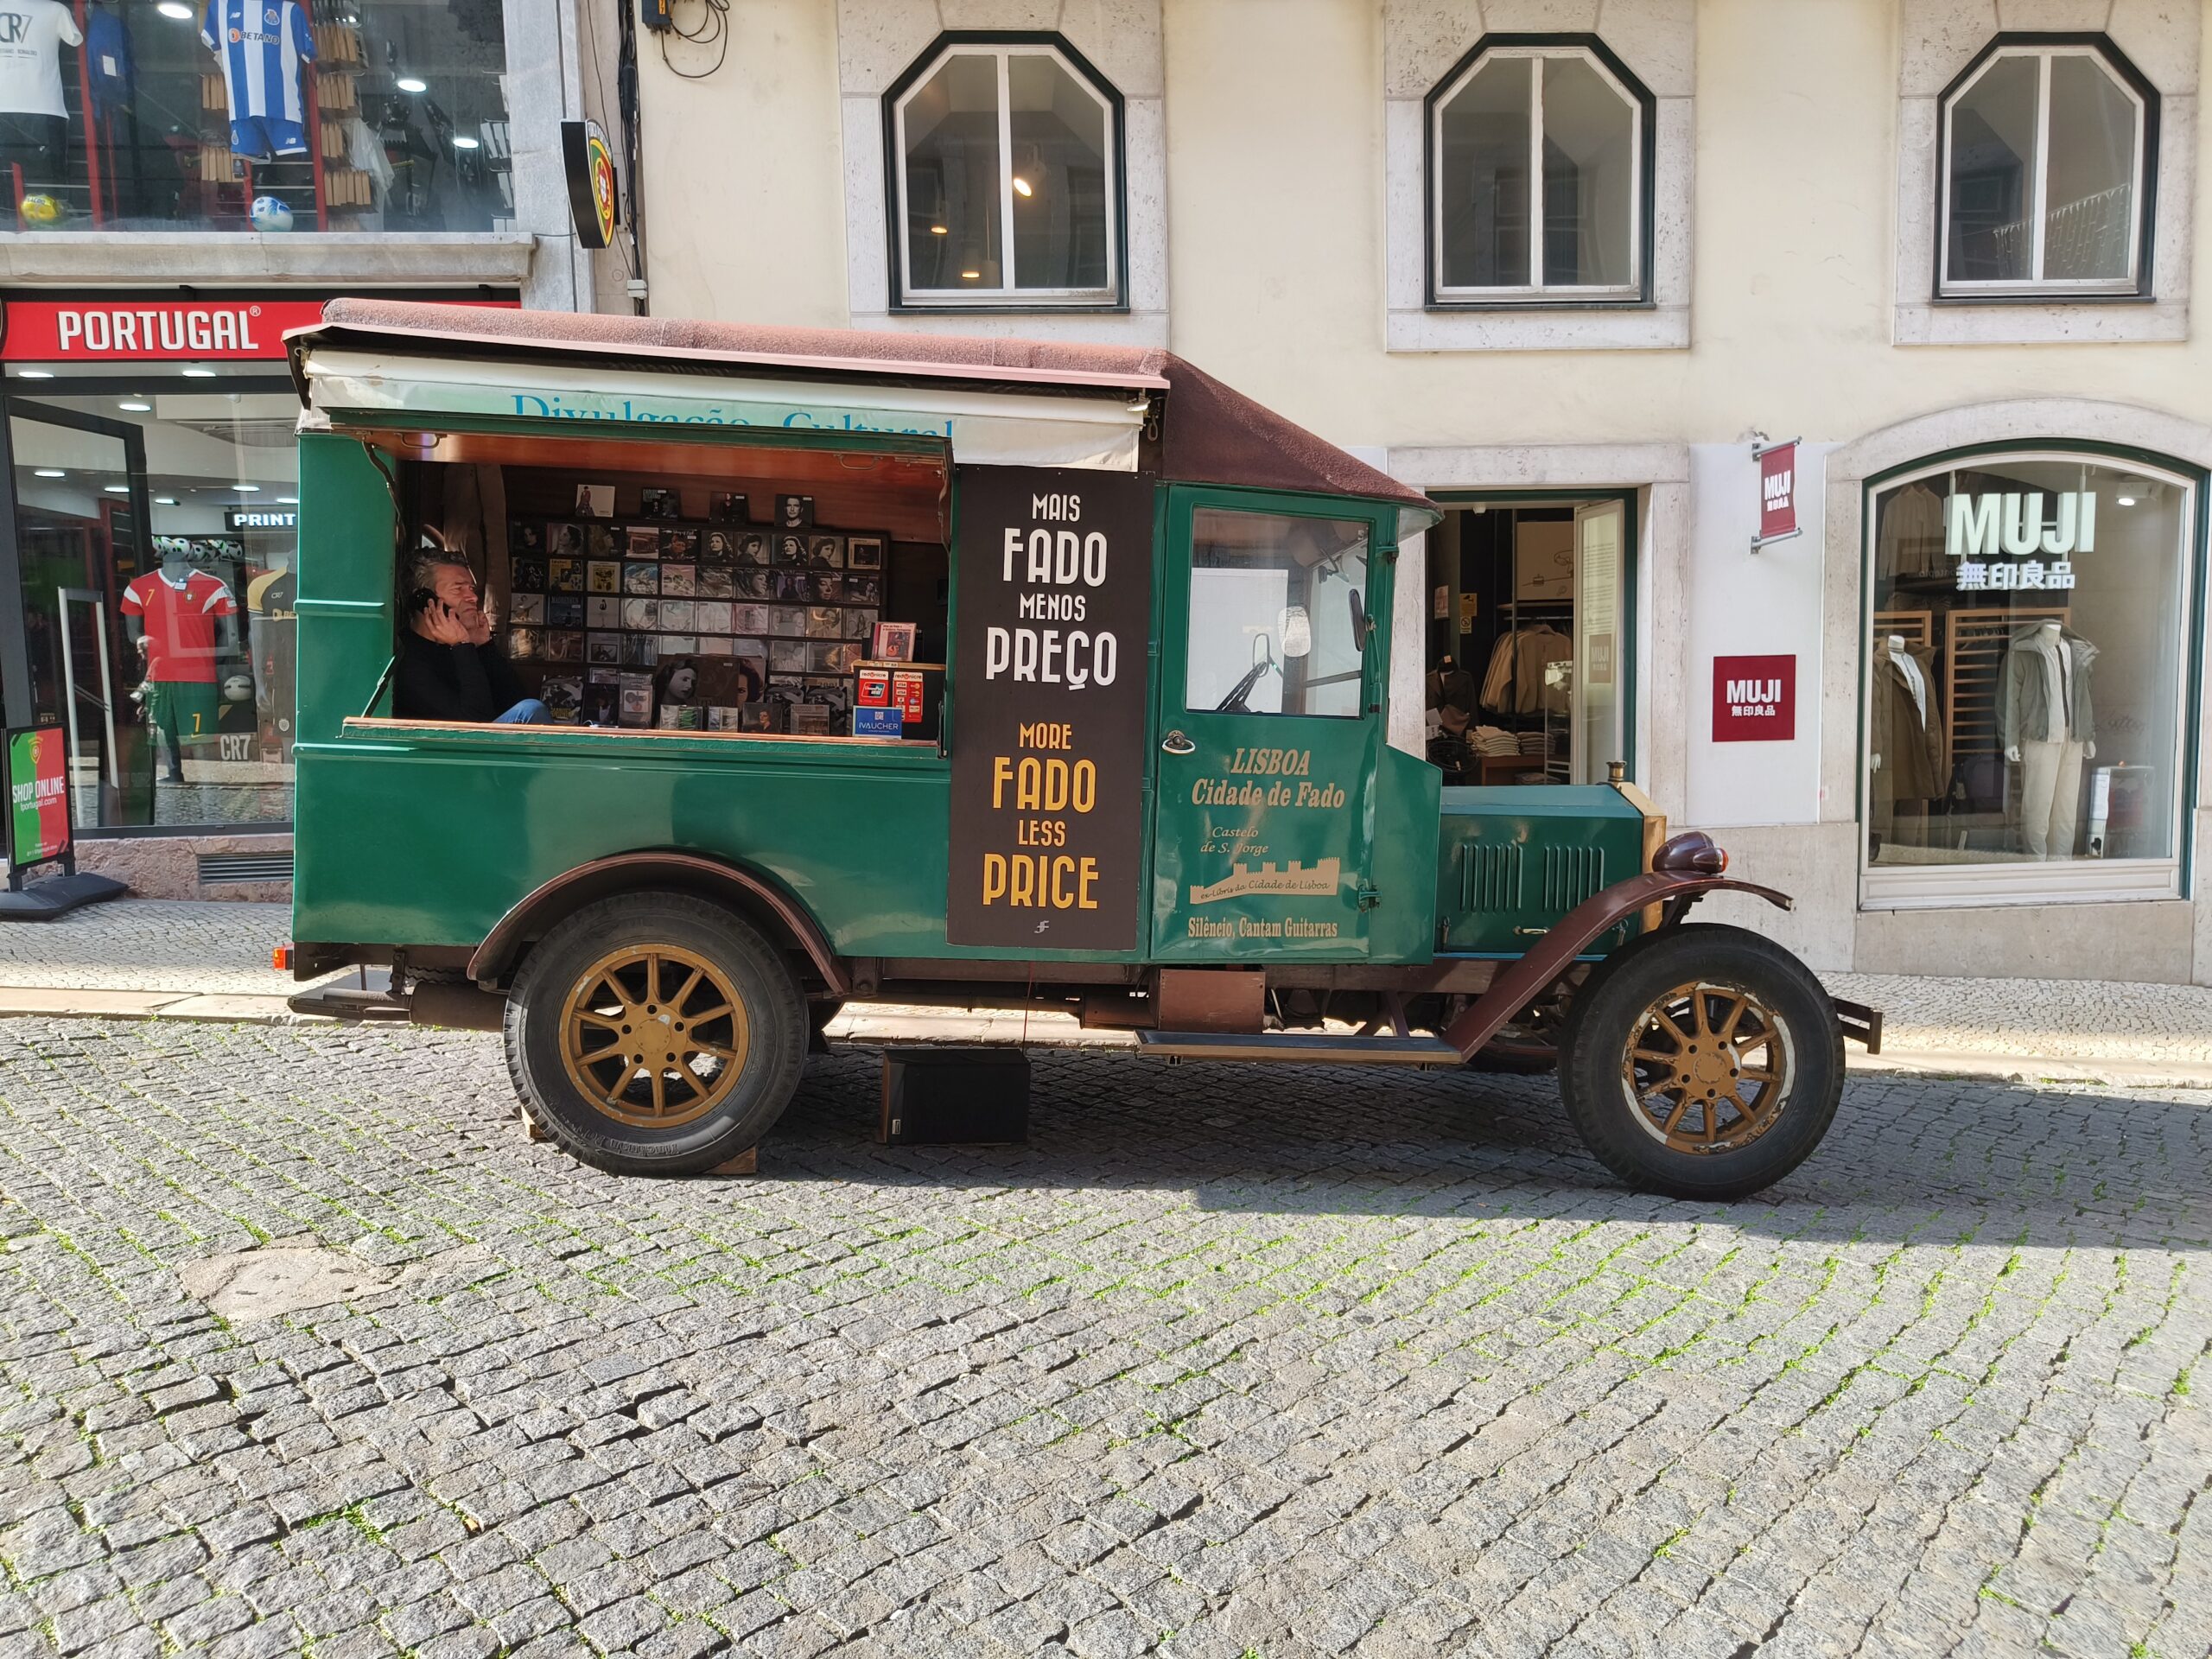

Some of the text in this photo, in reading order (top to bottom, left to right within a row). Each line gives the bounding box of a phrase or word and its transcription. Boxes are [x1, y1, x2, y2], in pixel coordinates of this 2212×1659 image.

[241, 31, 280, 45] BETANO
[1764, 470, 1791, 501] MUJI
[233, 513, 296, 526] PRINT
[1032, 493, 1082, 523] MAIS
[1944, 491, 2097, 556] MUJI
[1002, 528, 1109, 588] FADO
[1956, 559, 2076, 591] 無印良品
[145, 588, 156, 607] 7
[1019, 593, 1087, 622] MENOS
[985, 626, 1118, 690] PREÇO
[1726, 679, 1782, 704] MUJI
[192, 713, 201, 733] 7
[1732, 705, 1776, 717] 無印良品
[859, 721, 899, 730] IVAUCHER
[1019, 722, 1073, 751] MORE
[219, 734, 251, 760] CR7
[1230, 747, 1311, 776] LISBOA
[12, 776, 65, 804] SHOP ONLINE
[992, 756, 1096, 813] FADO
[1192, 779, 1345, 808] Cidade de Fado
[1017, 819, 1066, 848] LESS
[1212, 826, 1259, 838] Castelo
[1200, 841, 1269, 856] de S. Jorge
[982, 853, 1099, 910] PRICE
[1248, 880, 1283, 889] Cidade
[1285, 880, 1298, 889] de
[1299, 880, 1331, 890] Lisboa
[1188, 917, 1338, 939] Silêncio, Cantam Guitarras
